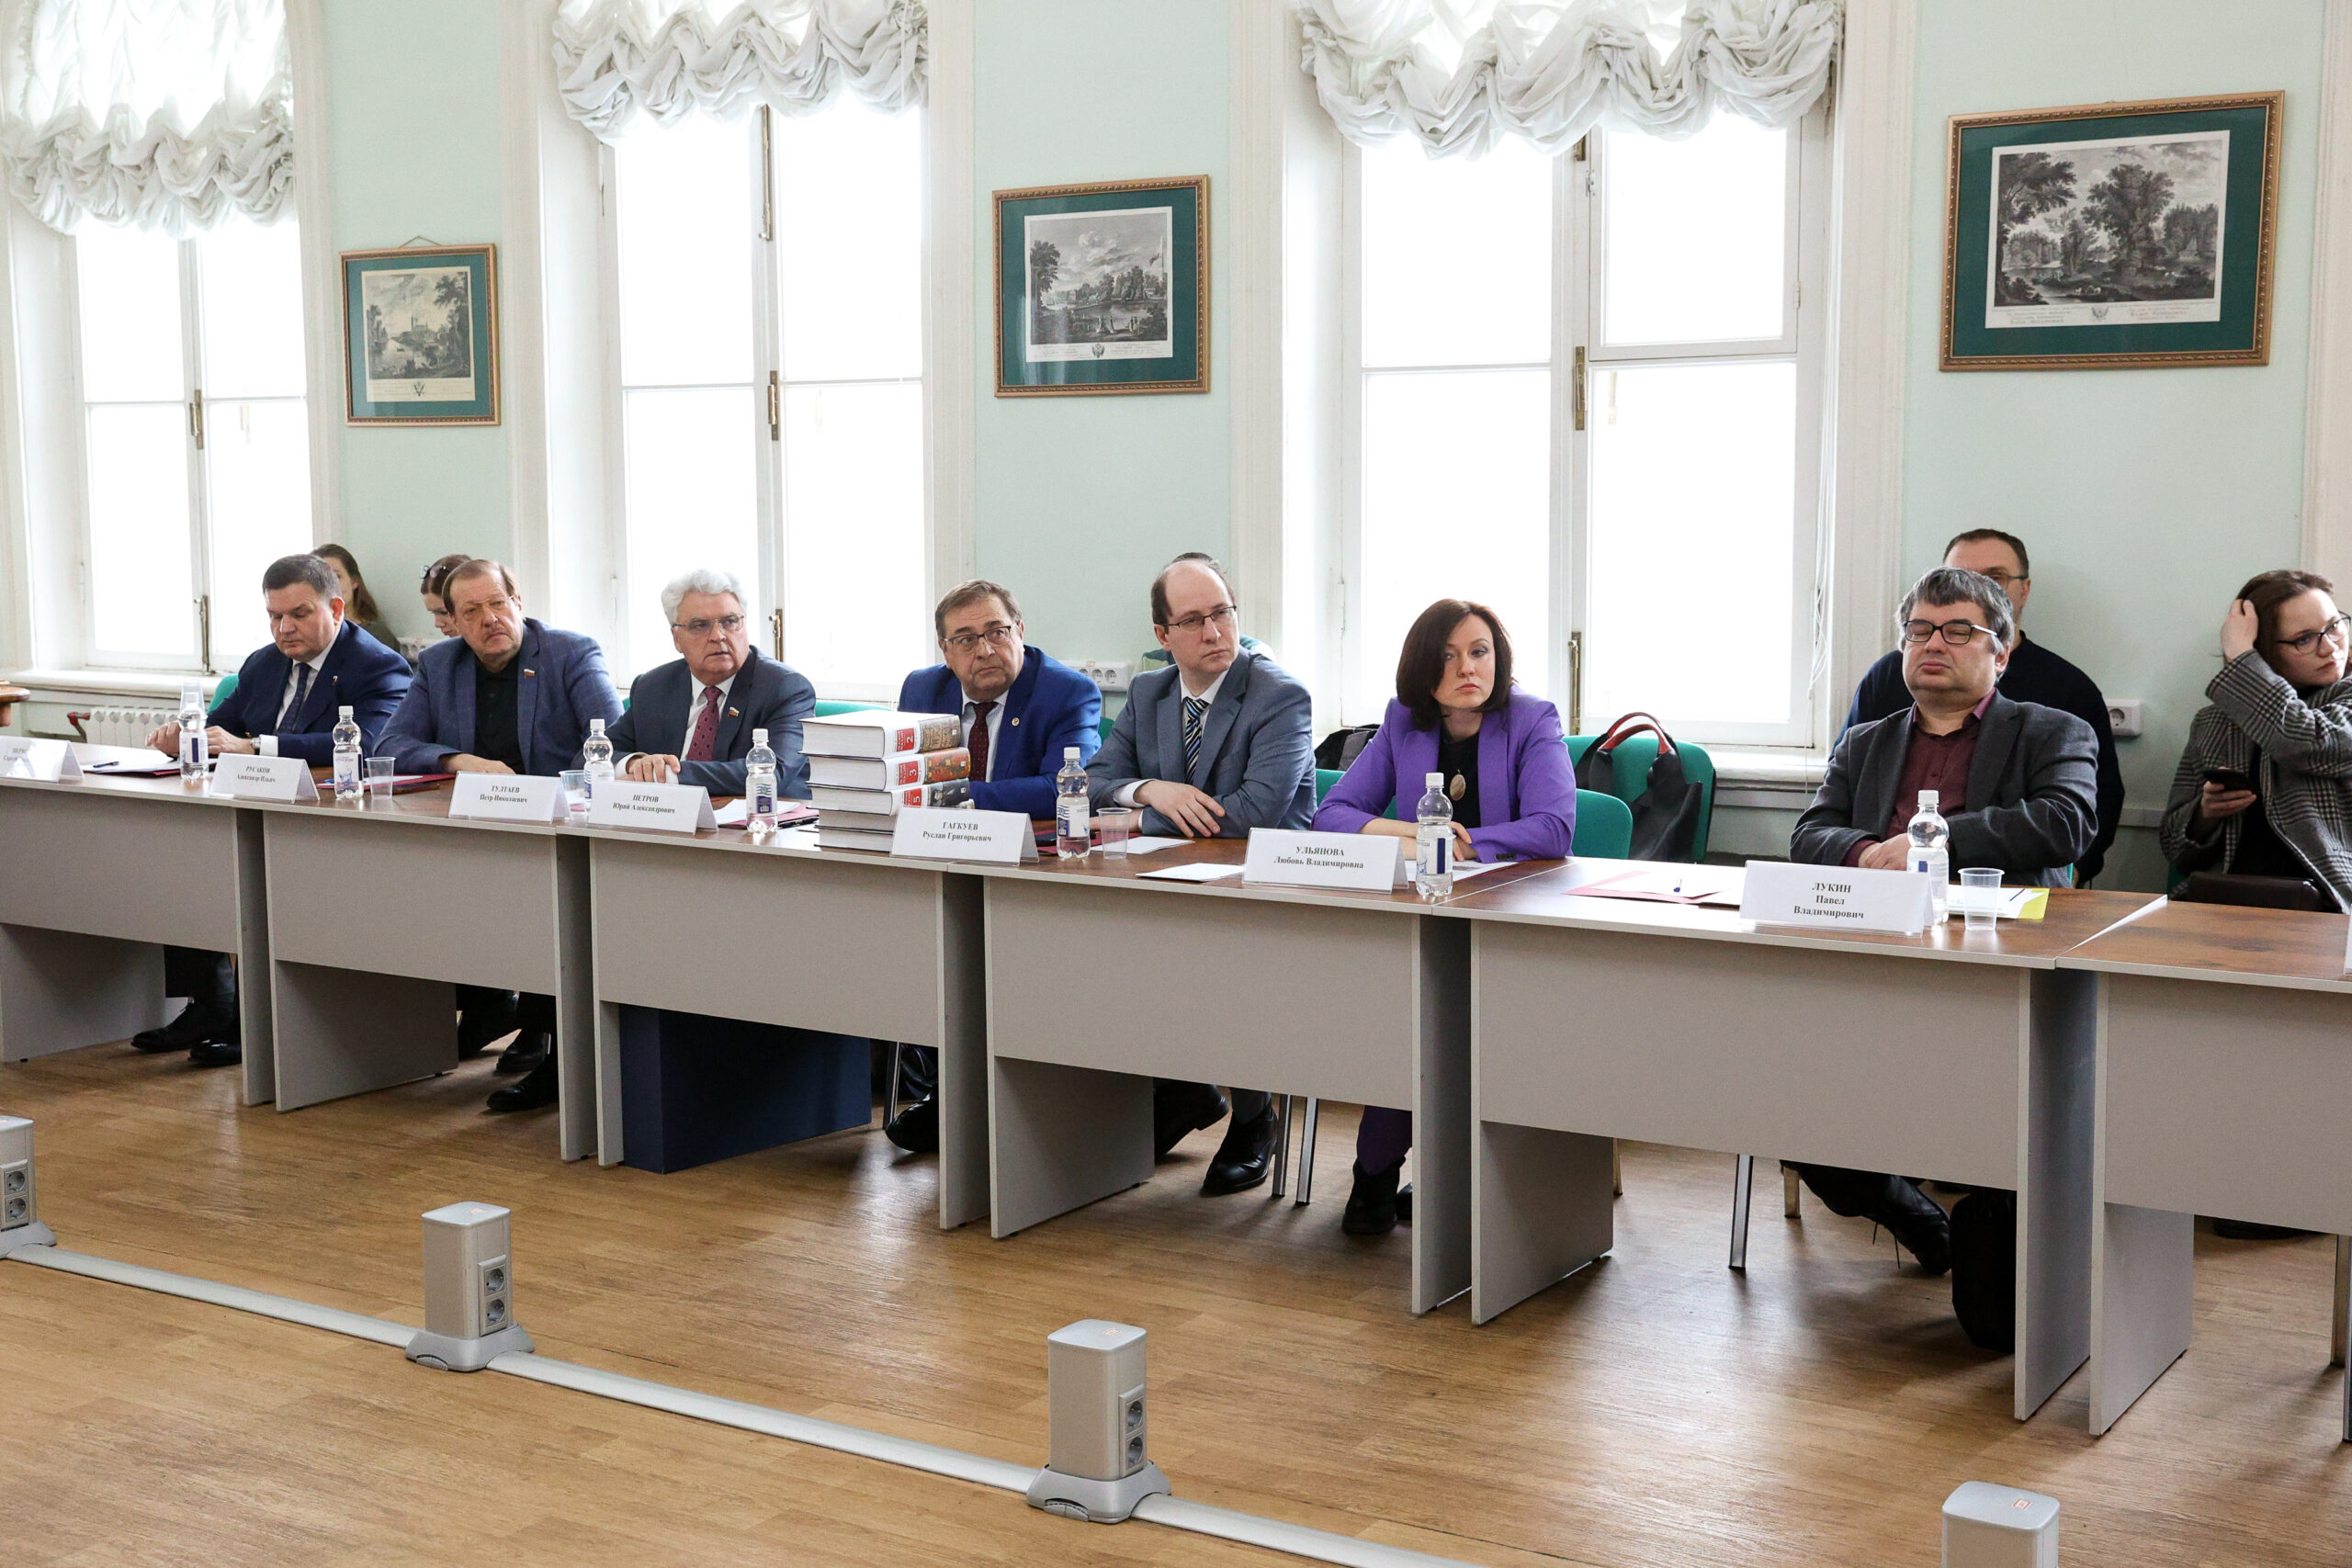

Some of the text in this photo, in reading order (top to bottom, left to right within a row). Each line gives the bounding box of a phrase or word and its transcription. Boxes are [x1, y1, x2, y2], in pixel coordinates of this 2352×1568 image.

[906, 735, 913, 743] 2
[909, 768, 917, 776] 3
[632, 794, 660, 803] ПЕТРОВ
[912, 795, 921, 804] 5
[613, 802, 675, 814] Юрий Александрович
[943, 821, 978, 831] ГАГКУЕВ
[922, 830, 992, 842] Руслан Григорьевич
[1295, 846, 1345, 856] УЛЬЯНОВА
[1273, 856, 1364, 869] Любовь Владимировна
[1812, 882, 1852, 894] ЛУКИН
[1815, 895, 1845, 905] Павел
[1793, 906, 1864, 919] Владимирович
